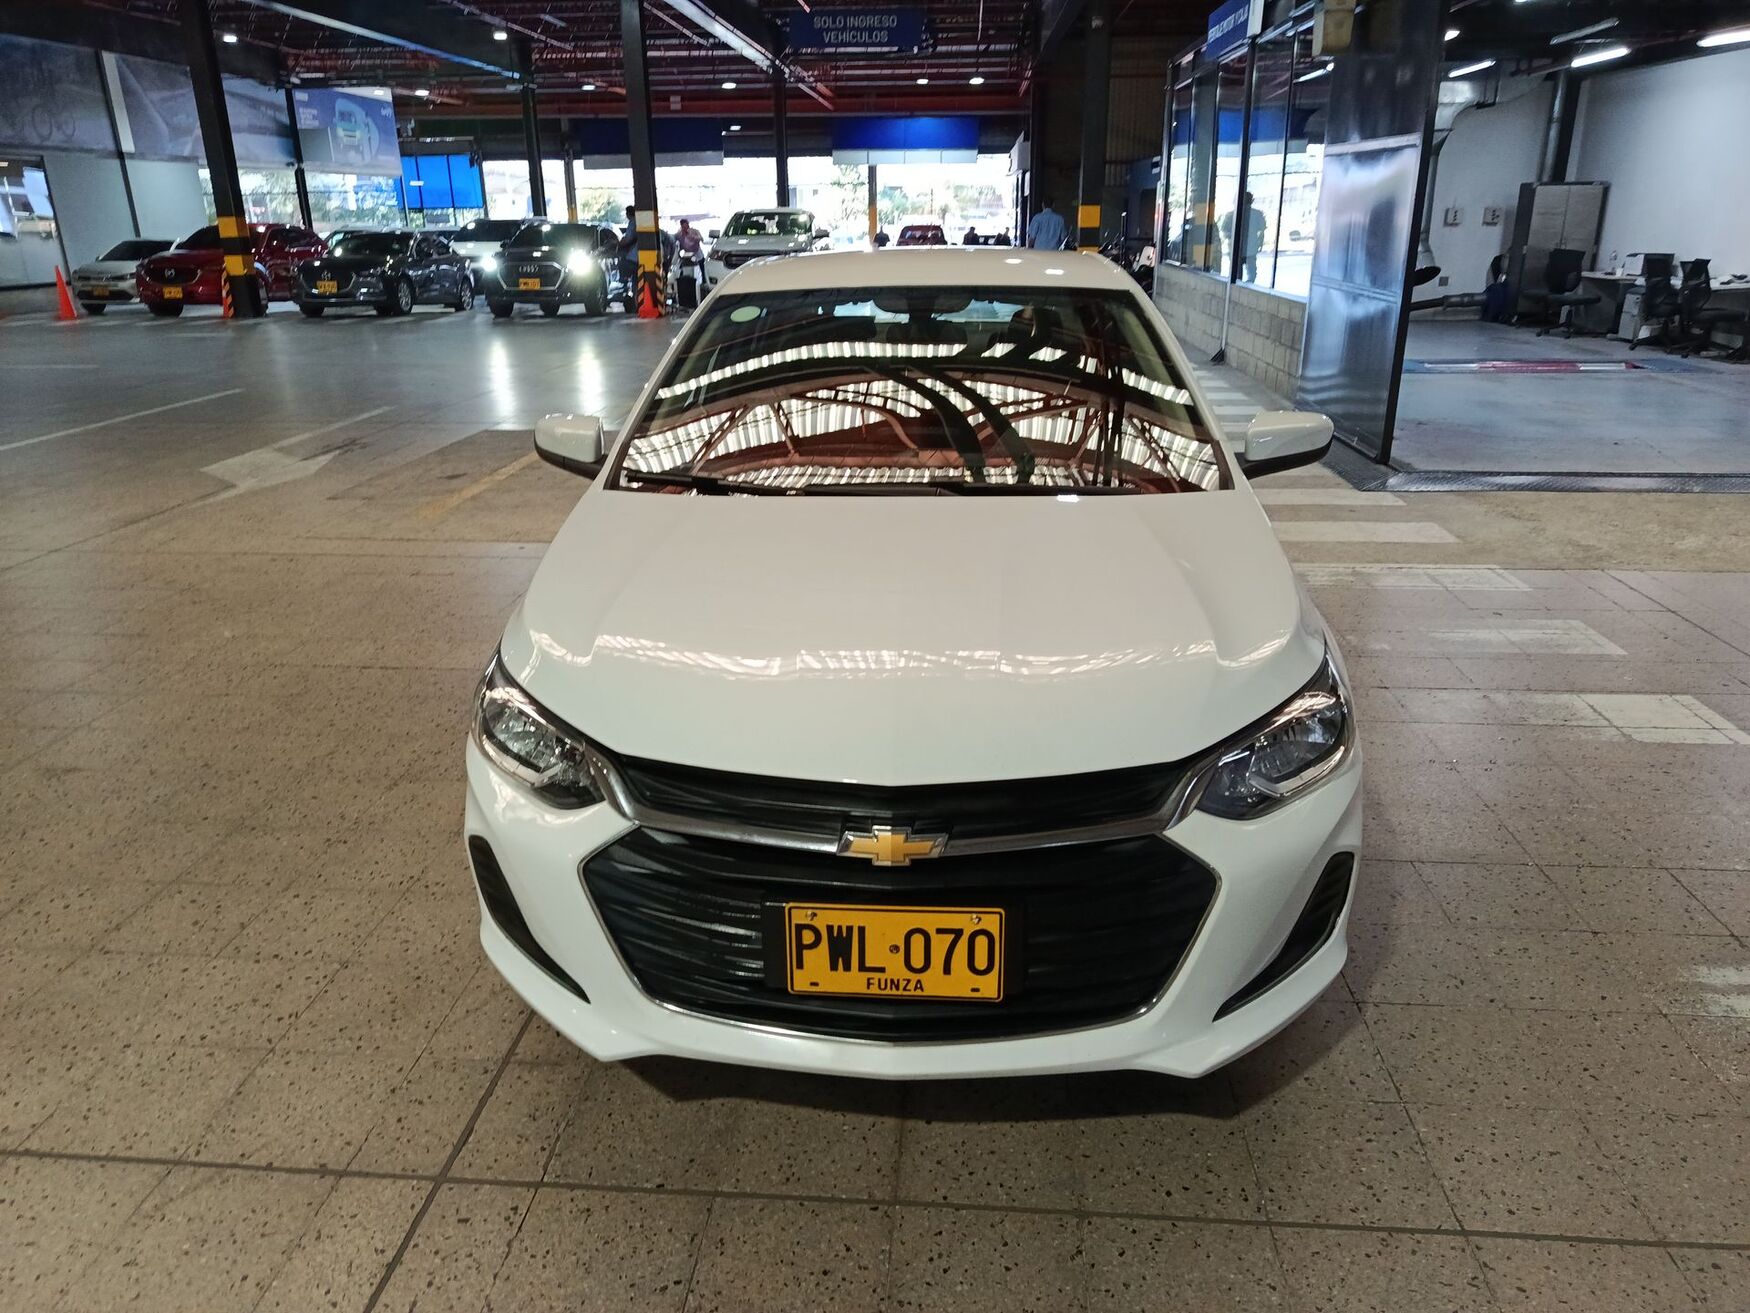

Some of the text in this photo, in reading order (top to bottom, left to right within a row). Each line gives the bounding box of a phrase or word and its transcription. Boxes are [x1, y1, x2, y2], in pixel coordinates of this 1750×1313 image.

[814, 15, 897, 29] SOLO INGRESO
[823, 29, 888, 43] VEHÍCULOS
[866, 977, 924, 992] FUNZA
